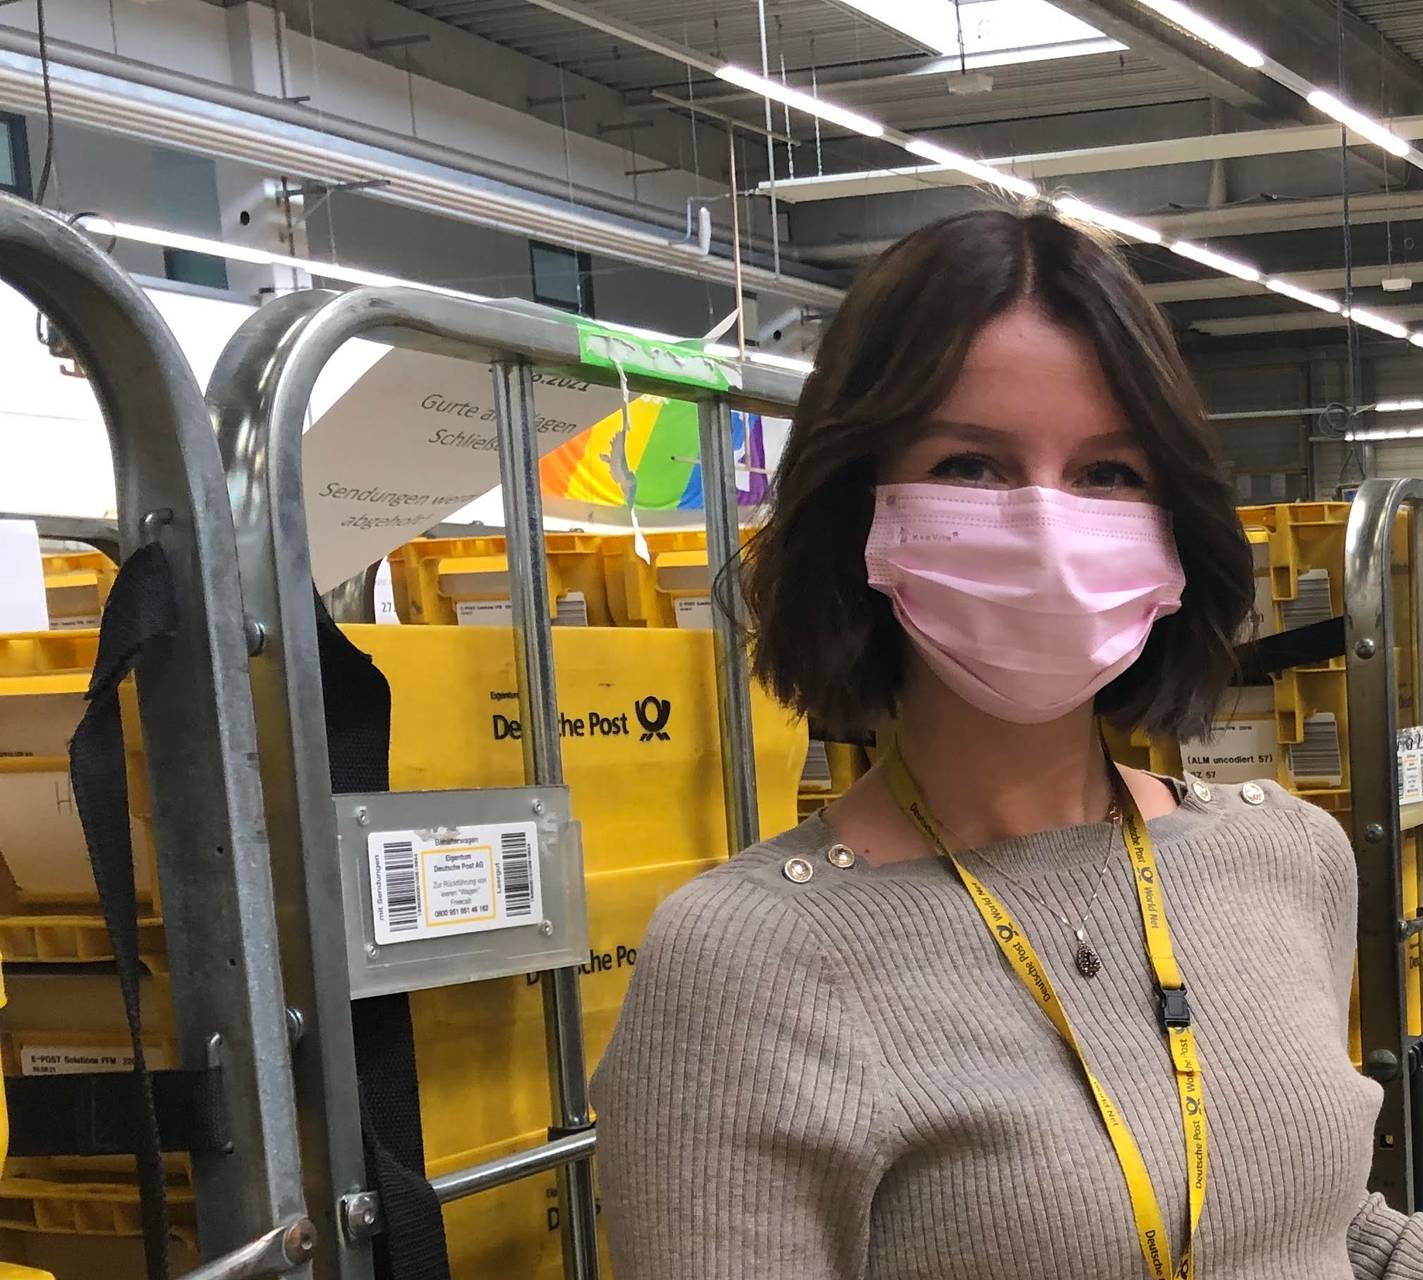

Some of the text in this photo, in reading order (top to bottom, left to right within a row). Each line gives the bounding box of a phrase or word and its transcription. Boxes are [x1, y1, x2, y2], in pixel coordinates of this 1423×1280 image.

[421, 393, 480, 418] Gurte
[533, 411, 577, 435] agen
[428, 428, 501, 452] Schließ
[319, 481, 429, 507] Sendungen
[588, 711, 630, 737] Post
[1187, 753, 1273, 766] (ALM uncodiert 57)
[1206, 770, 1216, 779] 57
[433, 861, 484, 873] Deutsche Post AG
[445, 854, 472, 863] Eigentum
[1134, 846, 1146, 864] Post
[374, 854, 383, 905] Sendungen
[1143, 886, 1160, 929] World Net
[616, 945, 637, 968] Po
[1012, 941, 1051, 1003] Deutsche Post
[31, 1054, 61, 1064] E-POST
[64, 1055, 98, 1065] Solutions
[1192, 1119, 1203, 1190] Deutsche Post
[1145, 1229, 1164, 1276] Deutsche
